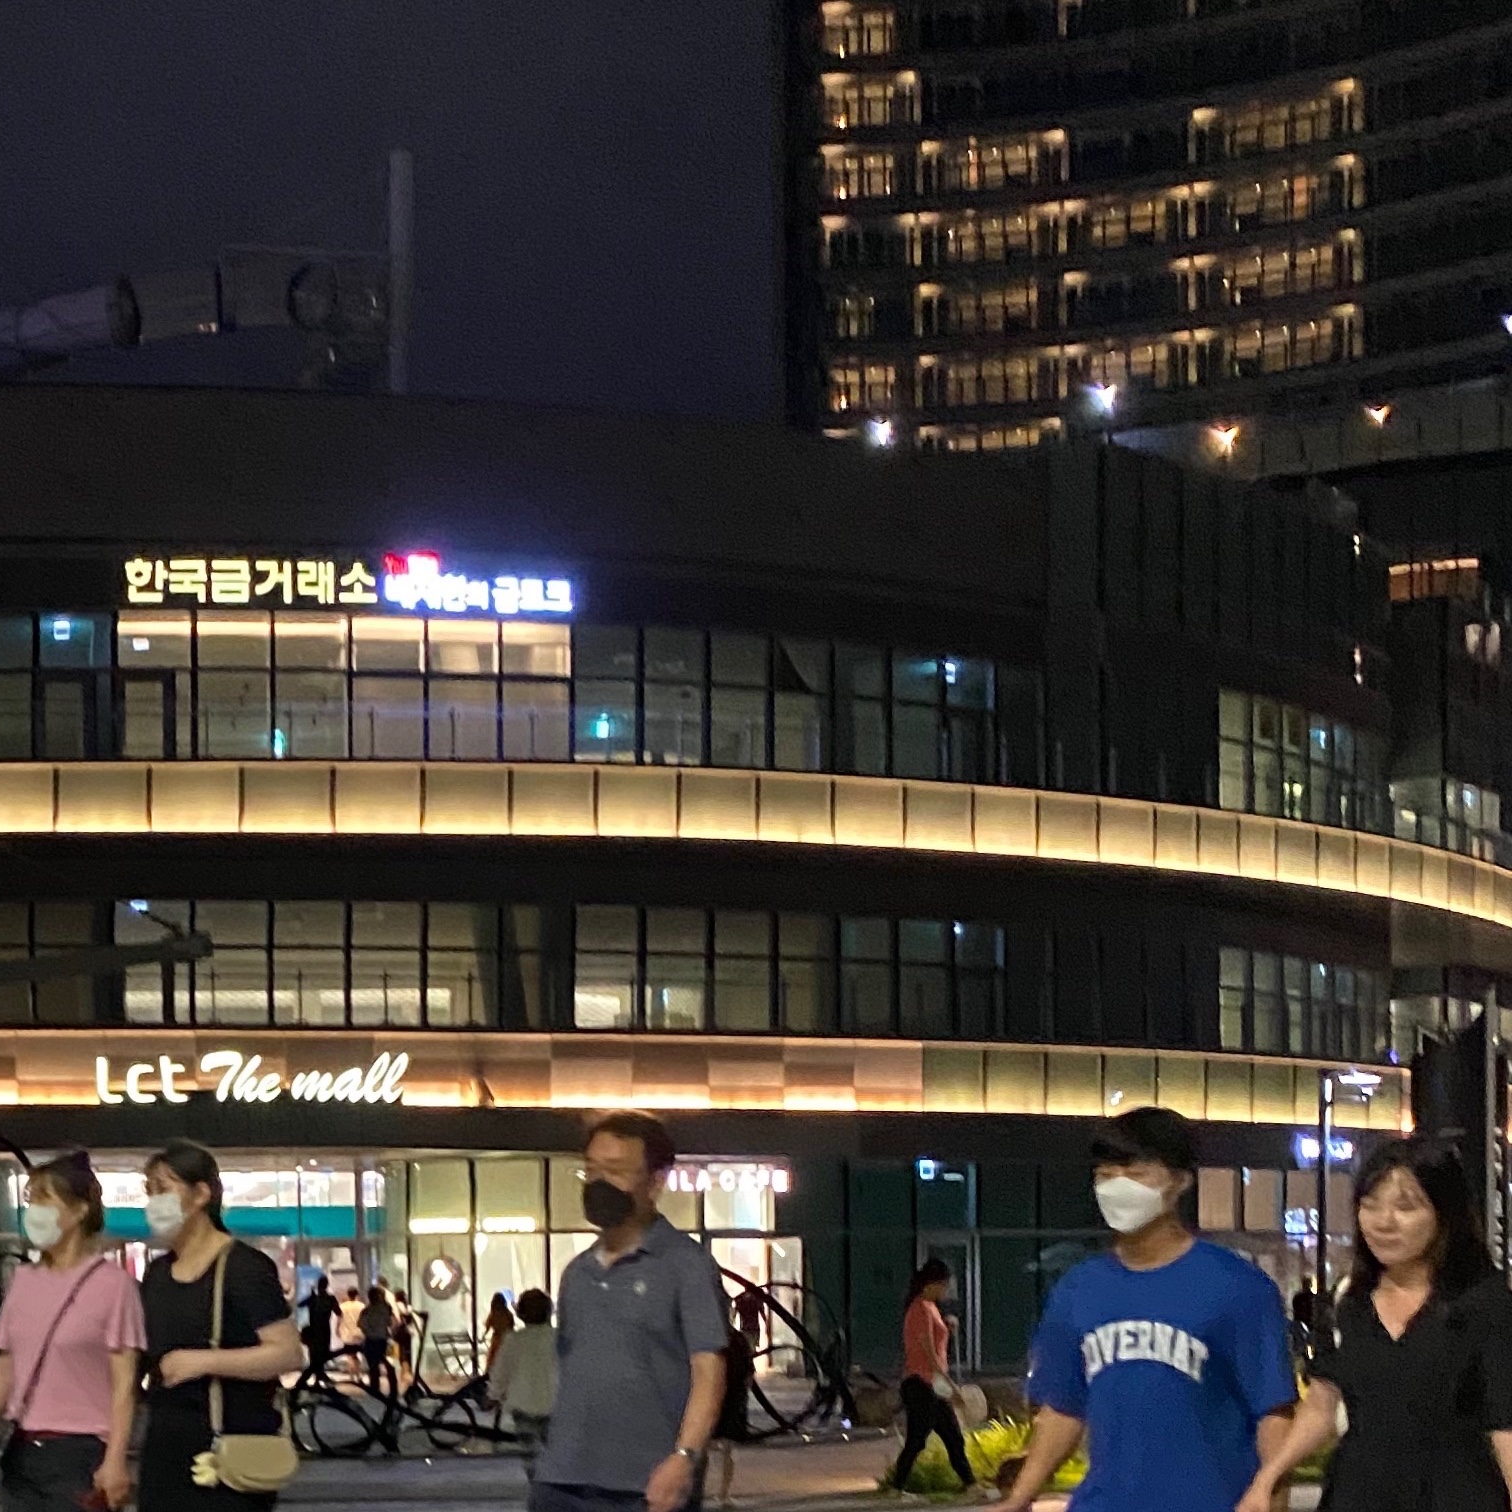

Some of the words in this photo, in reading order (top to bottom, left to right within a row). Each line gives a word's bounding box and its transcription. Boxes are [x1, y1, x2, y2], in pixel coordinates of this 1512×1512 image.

[125, 558, 377, 604] 한국금거래소
[200, 1050, 281, 1103] The
[290, 1052, 409, 1103] mall
